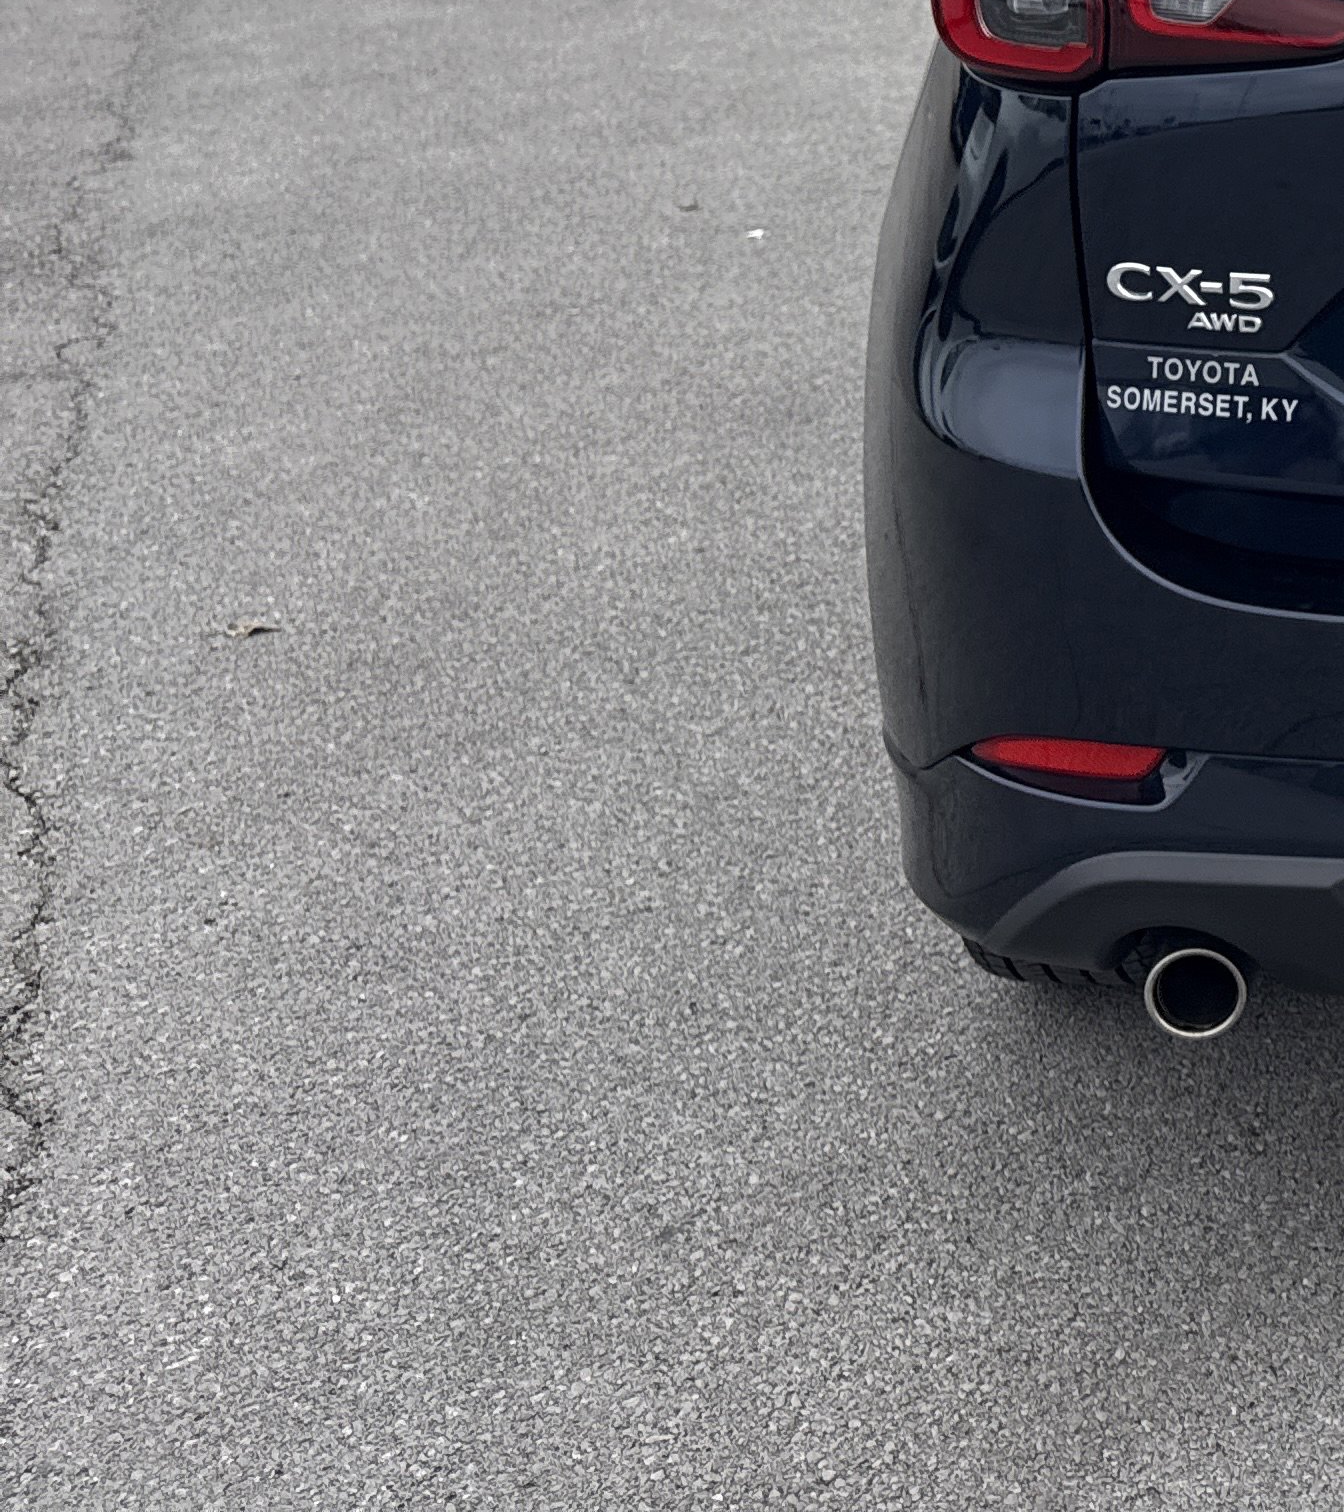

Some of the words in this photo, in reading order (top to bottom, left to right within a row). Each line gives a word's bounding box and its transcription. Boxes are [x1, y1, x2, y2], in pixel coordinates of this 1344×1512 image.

[1105, 261, 1275, 311] CX-5
[1186, 311, 1263, 334] AWD
[1147, 355, 1260, 387] TOYOTA
[1106, 384, 1253, 425] SOMERSET,
[1260, 396, 1299, 423] KY
